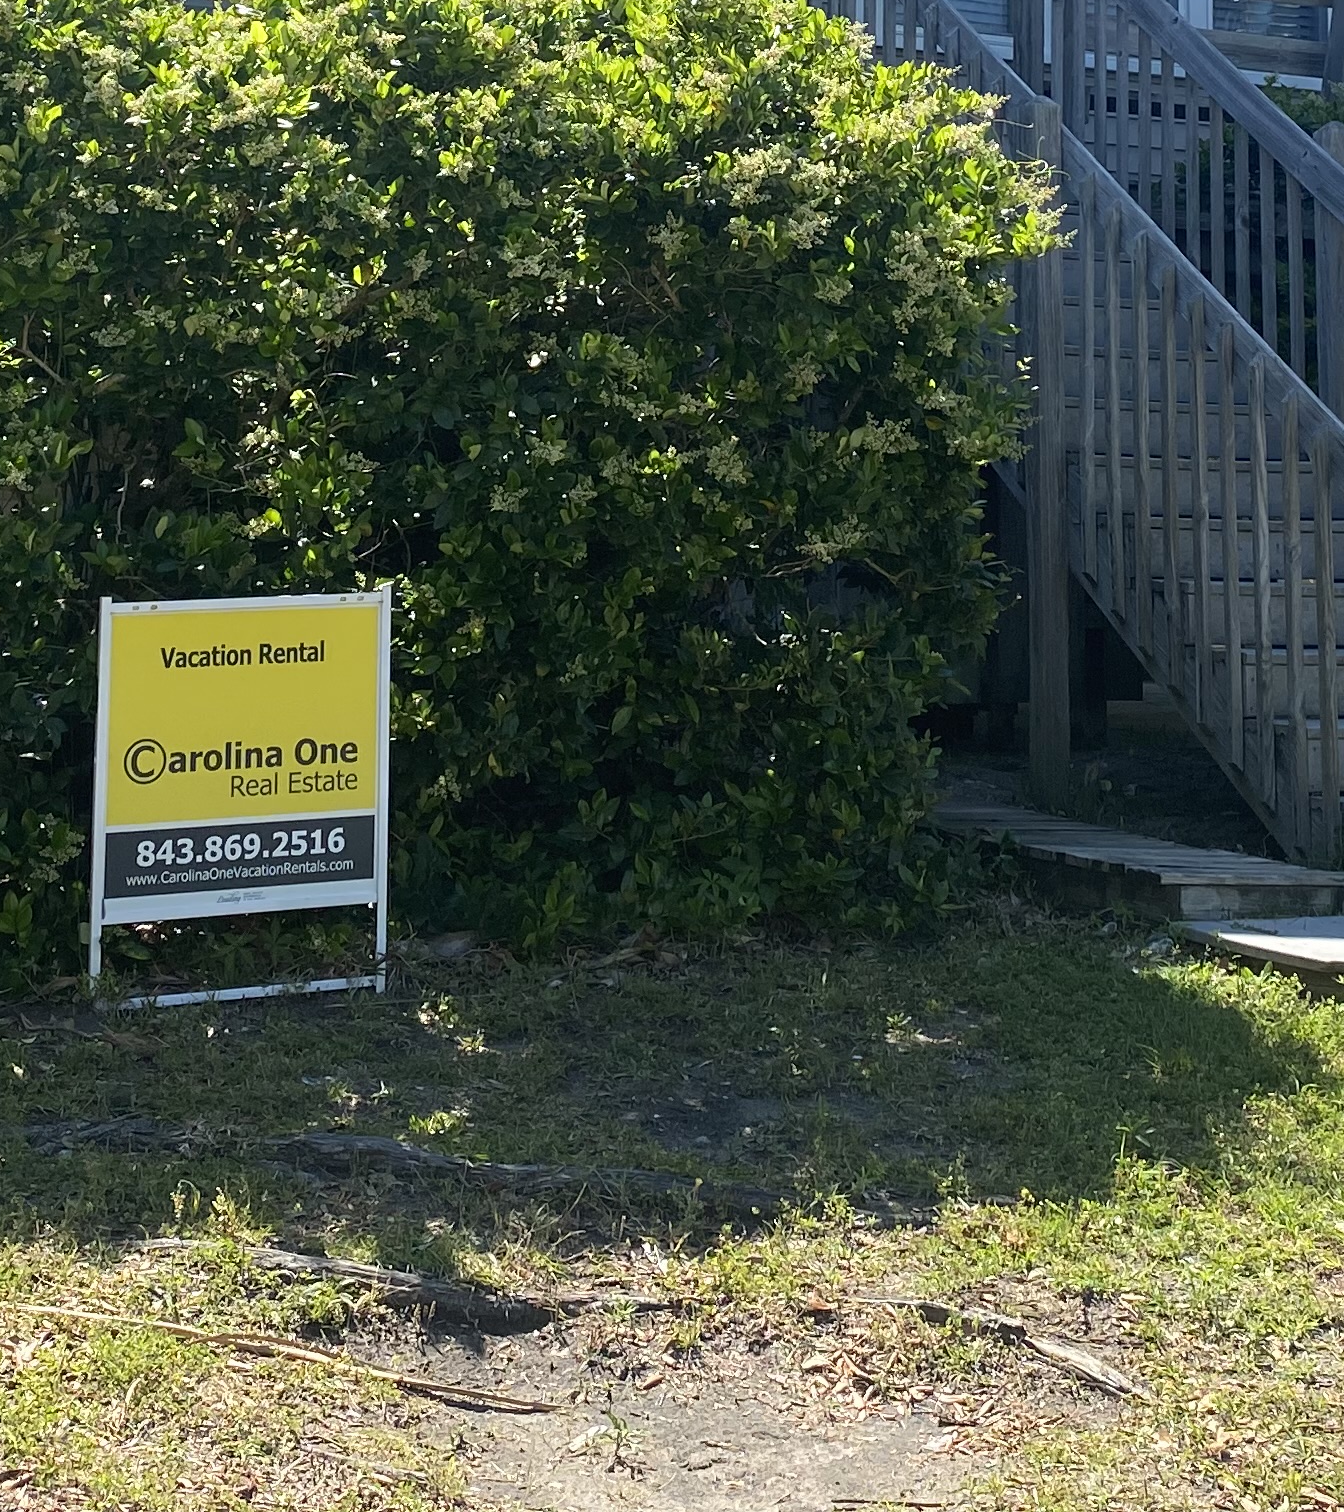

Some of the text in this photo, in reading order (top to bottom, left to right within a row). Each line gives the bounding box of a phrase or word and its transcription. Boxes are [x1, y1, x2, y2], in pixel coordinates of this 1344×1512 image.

[161, 640, 325, 669] Vacation Rental
[124, 737, 358, 785] Carolina One
[230, 768, 358, 798] Real Estate
[136, 827, 346, 867] 843.869.2516
[126, 857, 354, 886] www.CarolinaOneVacationRentals.com
